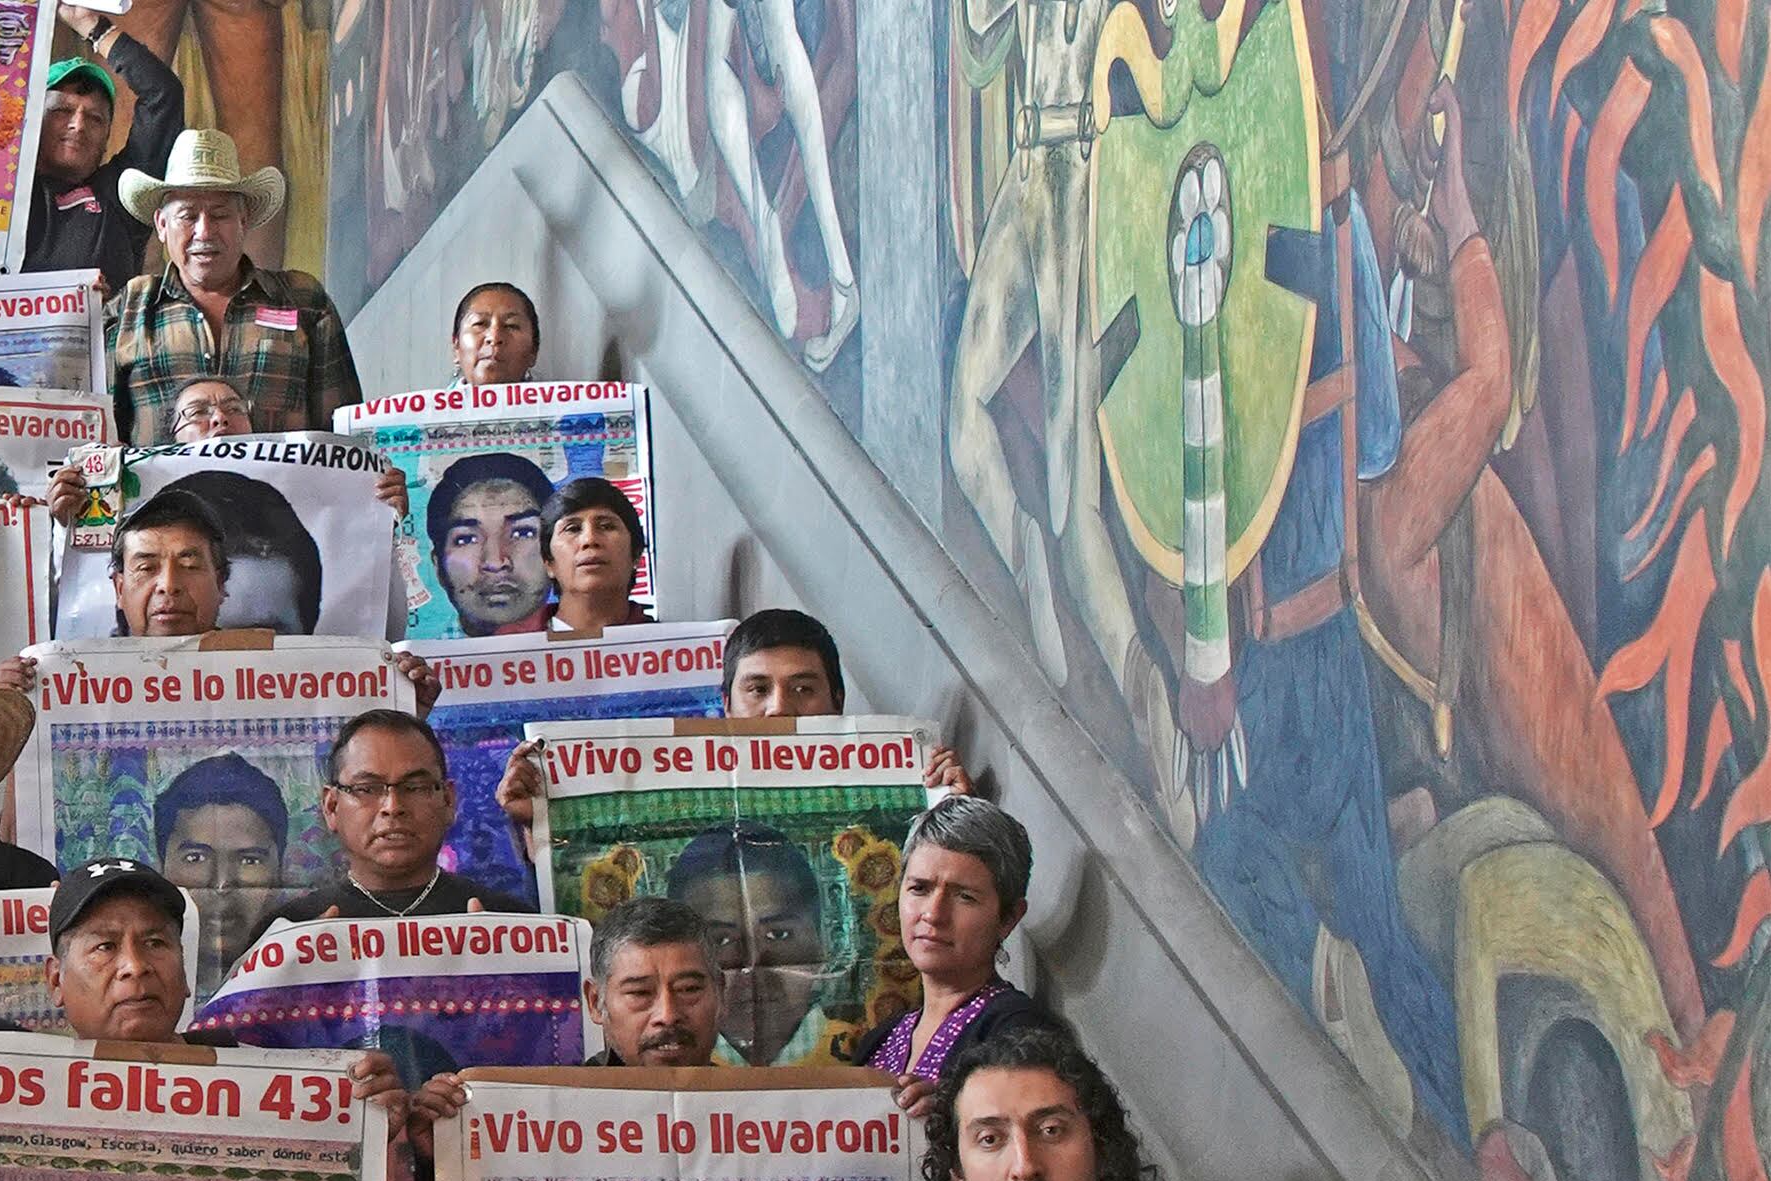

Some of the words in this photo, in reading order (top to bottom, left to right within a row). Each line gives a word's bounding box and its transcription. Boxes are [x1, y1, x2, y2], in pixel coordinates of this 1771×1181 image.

[435, 389, 463, 410] se
[473, 385, 497, 408] lo
[507, 383, 627, 406] llevaron!
[85, 454, 104, 474] 43
[200, 443, 246, 460] LOS
[254, 443, 385, 475] LLEVARON!
[502, 659, 536, 685] se
[546, 653, 575, 682] lo
[583, 640, 723, 679] llevaron!
[41, 672, 133, 711] ¡Vivo
[145, 674, 181, 702] se
[192, 667, 226, 701] lo
[237, 664, 388, 700] llevaron!
[547, 741, 641, 784] ¡Vivo
[654, 746, 693, 773] se
[705, 740, 739, 771] lo
[750, 738, 914, 770] llevaron!
[297, 932, 338, 965] se
[349, 924, 385, 960] lo
[397, 922, 570, 958] llevaron!
[67, 1060, 240, 1118] faltan
[258, 1074, 353, 1124] 43!
[171, 1143, 218, 1158] quiero
[227, 1145, 265, 1159] saber
[469, 1110, 583, 1160] ¡Vivo
[598, 1119, 643, 1154] se
[656, 1113, 696, 1154] lo
[710, 1113, 899, 1155] llevaron!
